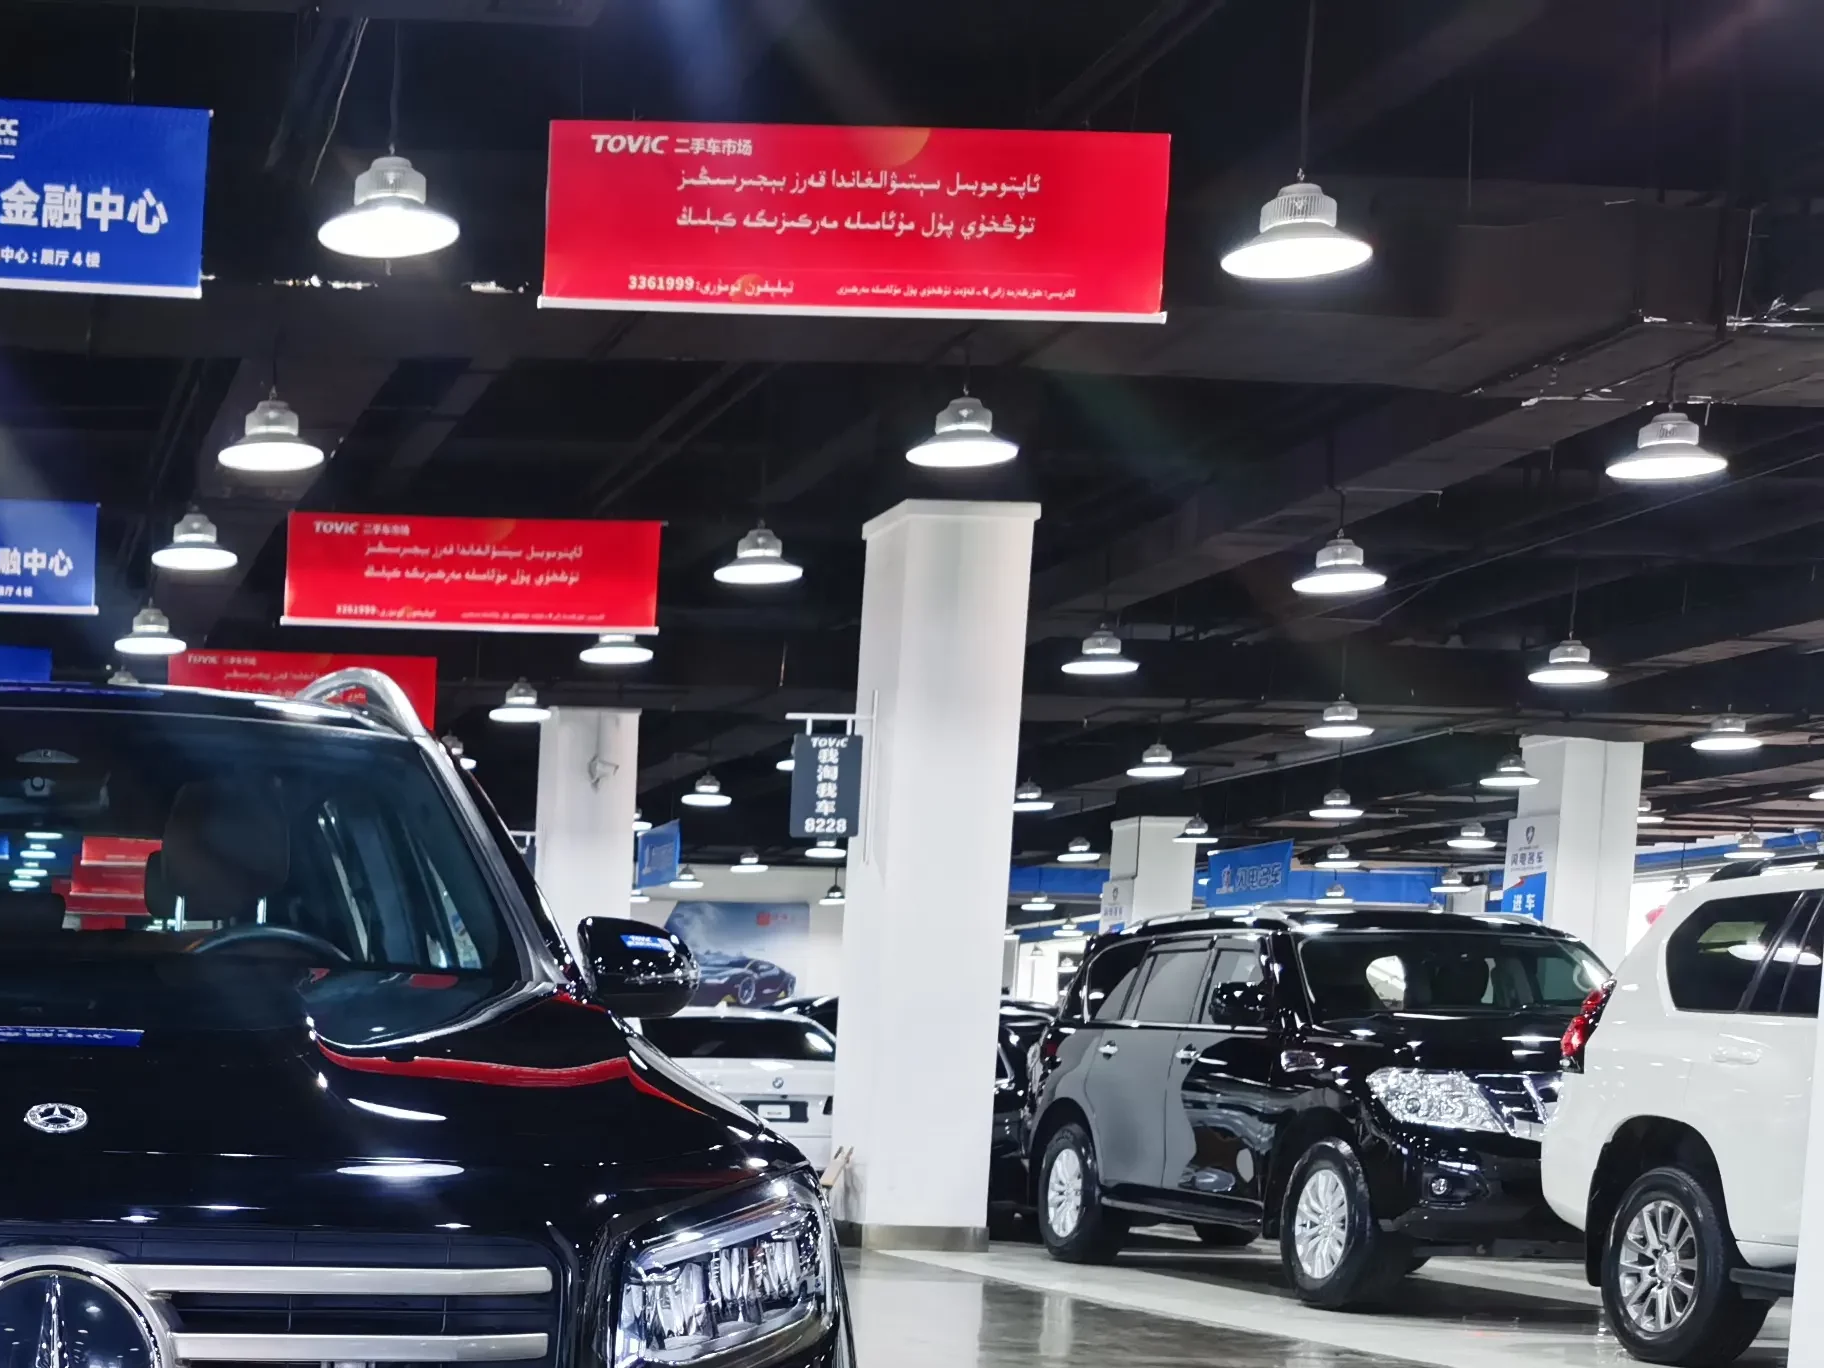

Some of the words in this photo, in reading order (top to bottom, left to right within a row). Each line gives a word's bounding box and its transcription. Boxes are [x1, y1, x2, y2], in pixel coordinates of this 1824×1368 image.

[590, 134, 669, 154] TOVIC
[674, 138, 753, 156] 二手车市场
[810, 737, 848, 748] TOVIC
[804, 817, 847, 834] 8228
